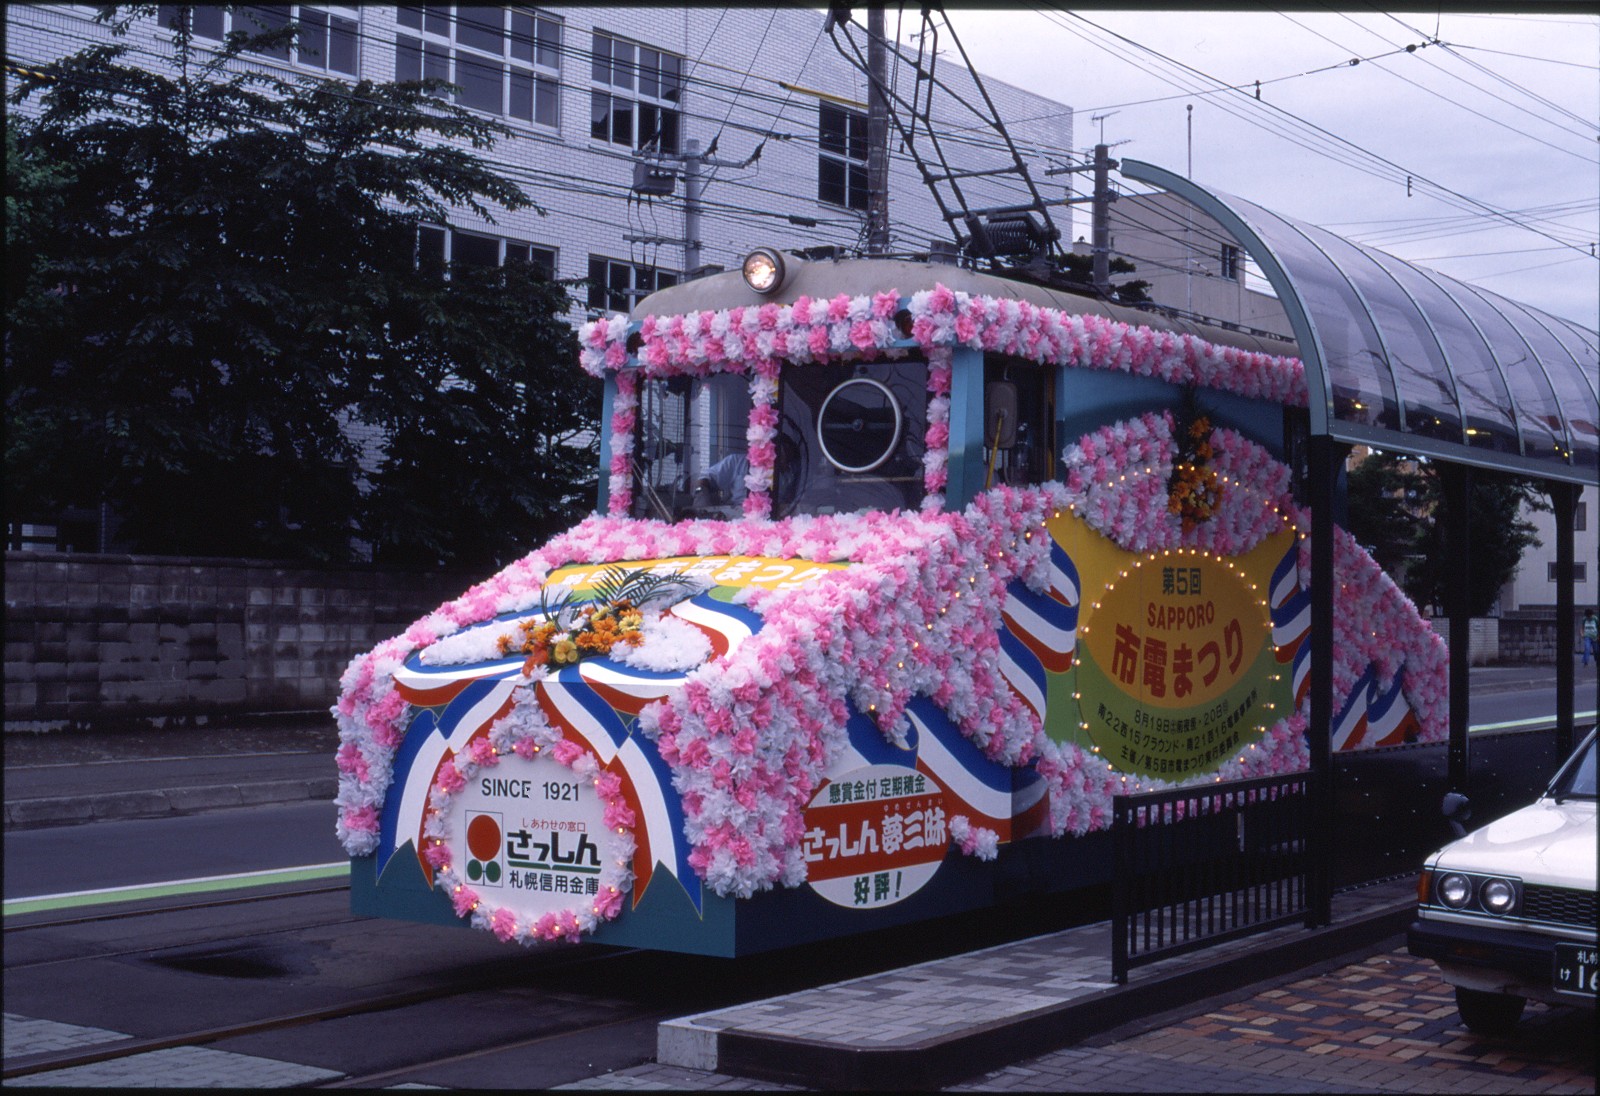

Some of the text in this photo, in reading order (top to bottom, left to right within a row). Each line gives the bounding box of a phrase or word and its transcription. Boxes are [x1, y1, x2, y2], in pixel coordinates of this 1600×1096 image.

[1162, 567, 1201, 595] 第5回
[1147, 600, 1215, 631] SAPPORO
[1111, 618, 1243, 698] 市電まつり
[481, 778, 579, 801] SINCE 1921
[829, 773, 926, 803] 懸賞金付 定期積金
[522, 817, 586, 832] しあわせの窓口
[507, 829, 601, 867] さっしん
[509, 870, 599, 896] 札幌信用金庫
[1560, 967, 1571, 981] け
